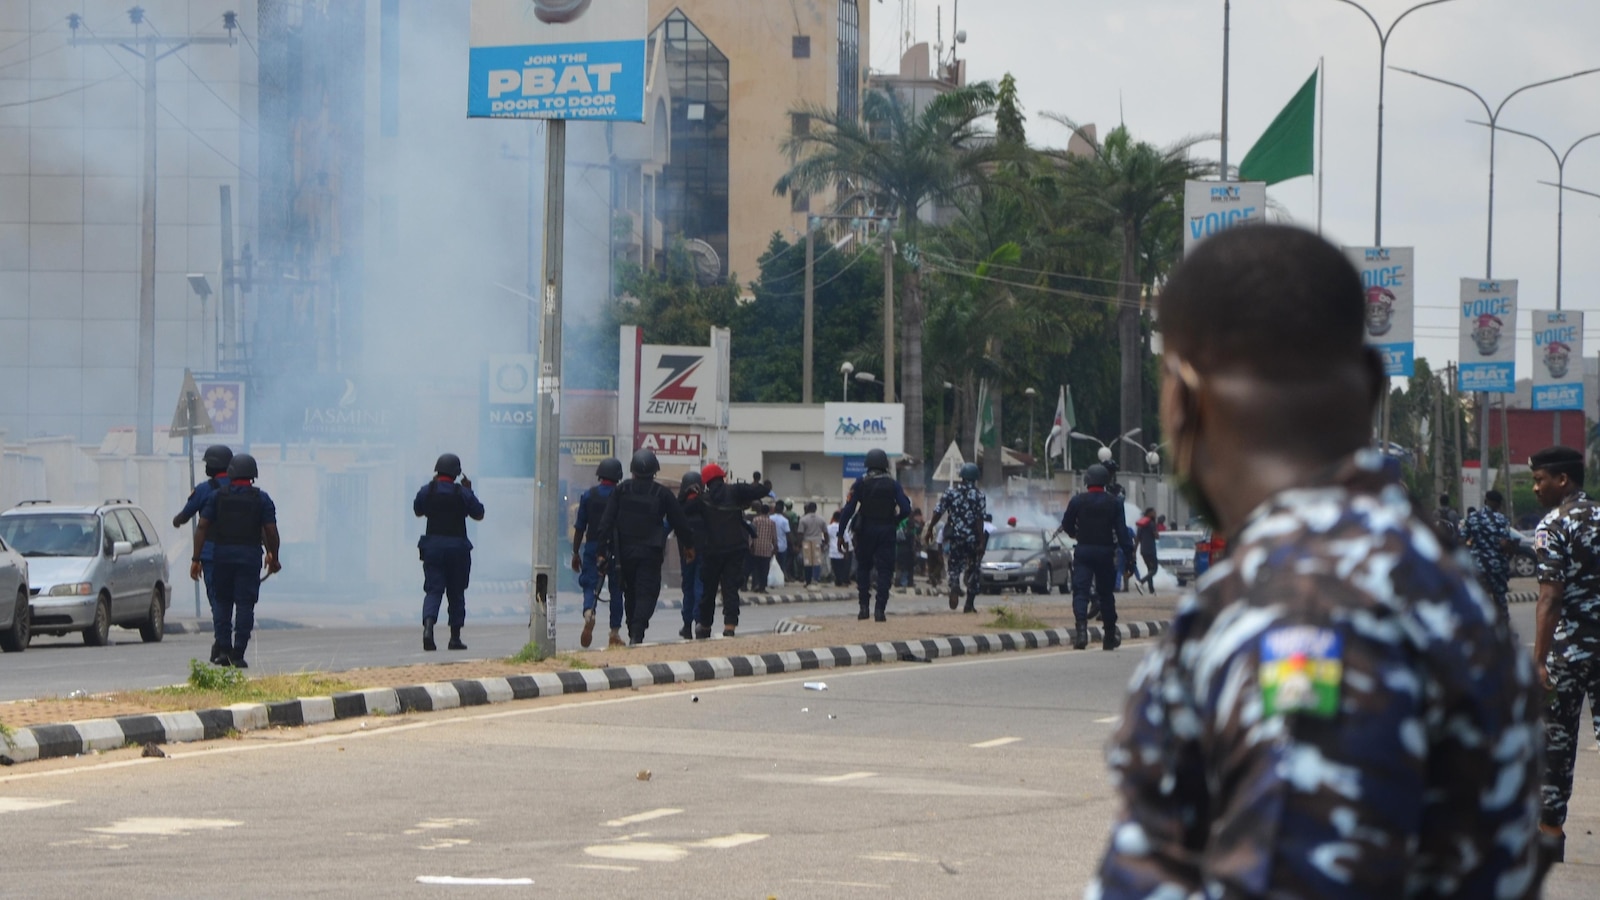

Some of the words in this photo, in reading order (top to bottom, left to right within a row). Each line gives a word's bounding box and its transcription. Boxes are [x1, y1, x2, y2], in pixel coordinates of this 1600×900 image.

[524, 56, 557, 66] JOIN
[559, 53, 588, 63] THE
[488, 63, 622, 99] PBAT
[491, 99, 540, 112] DOOR
[542, 97, 566, 108] TO
[568, 94, 616, 107] DOOR
[569, 106, 617, 117] TODAY.
[1463, 297, 1511, 318] VOICE
[1534, 326, 1577, 346] VOICE
[1462, 368, 1510, 381] PBAT
[1536, 388, 1580, 402] PBAT
[646, 401, 698, 415] ZENITH
[304, 408, 393, 426] JASMINE
[490, 411, 534, 424] NAQS
[641, 434, 698, 451] ATM
